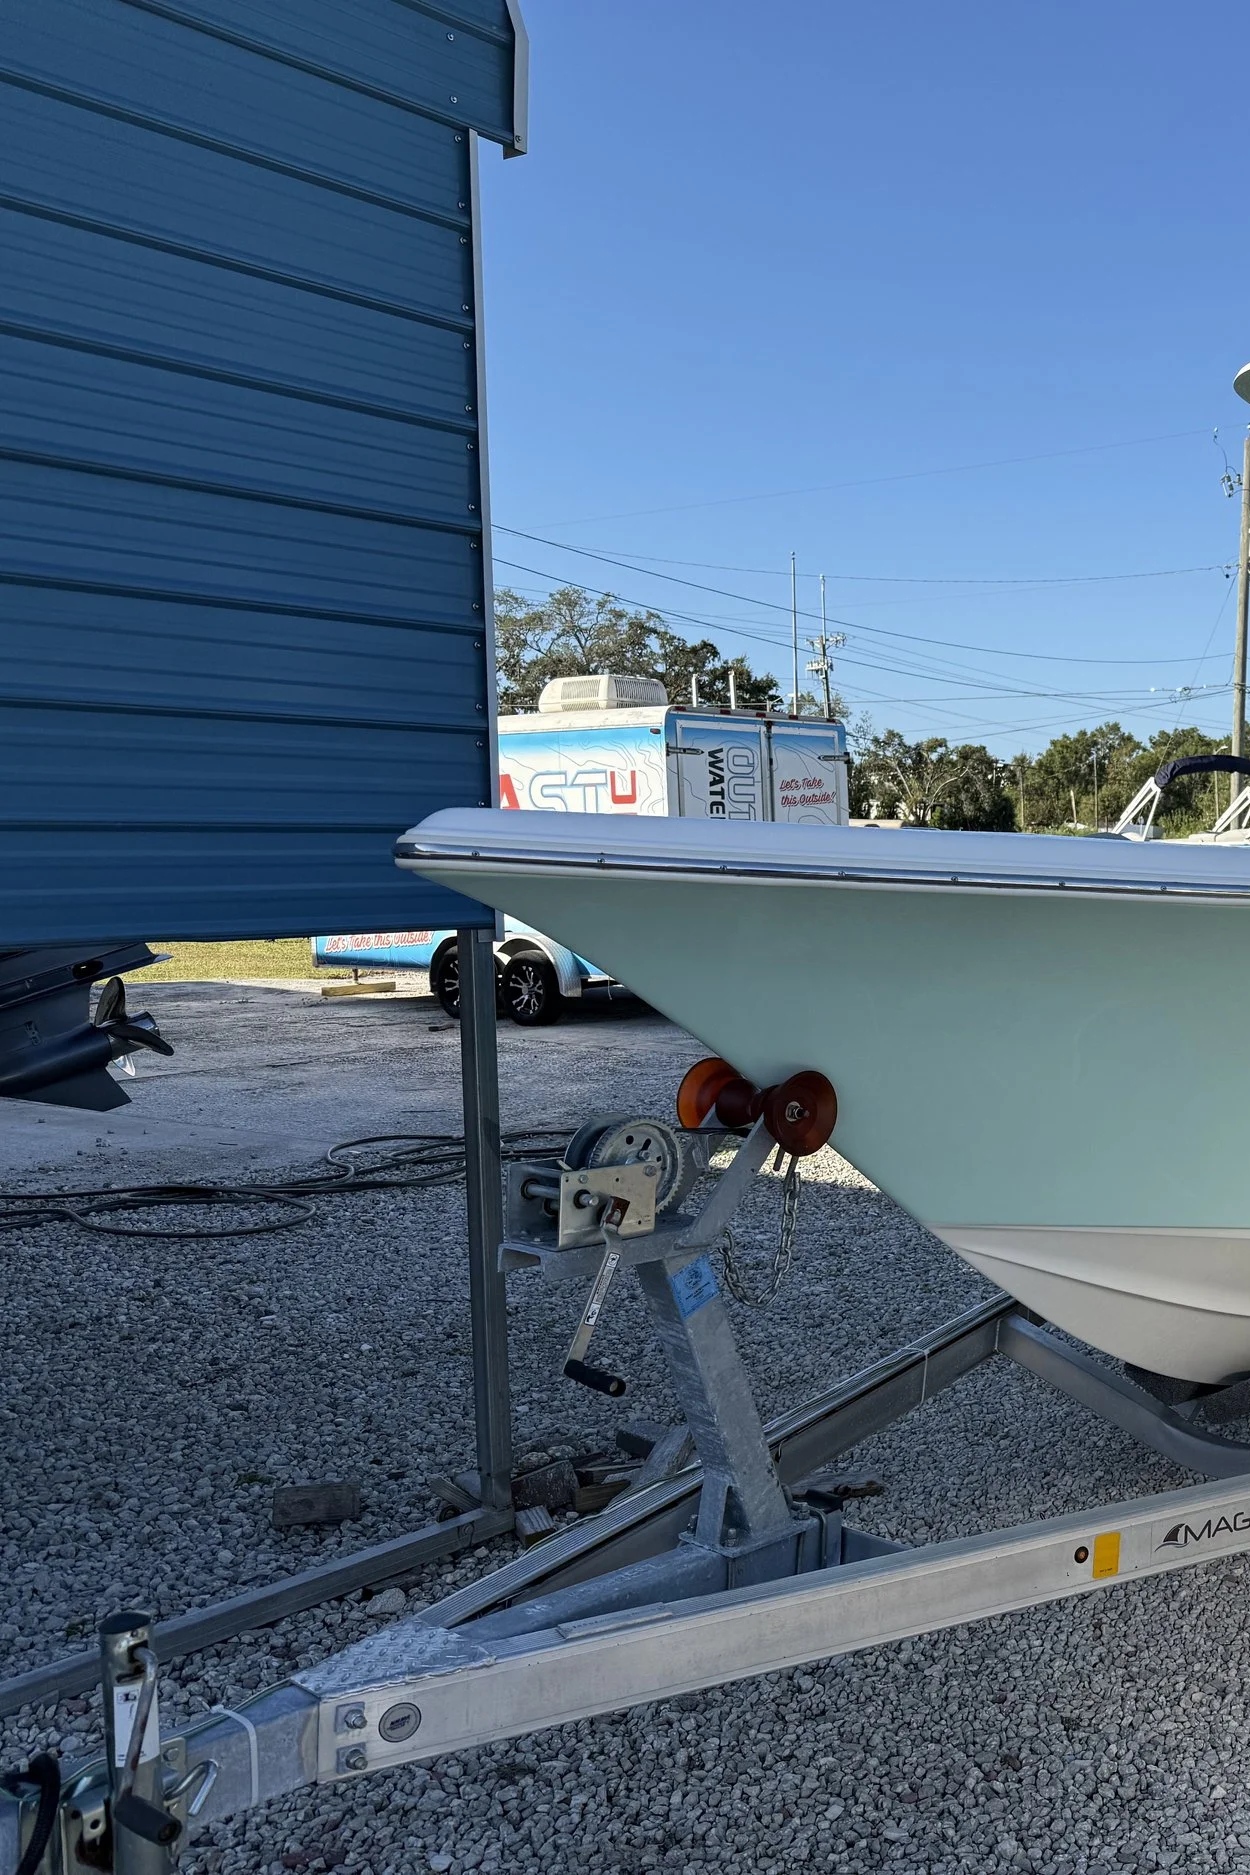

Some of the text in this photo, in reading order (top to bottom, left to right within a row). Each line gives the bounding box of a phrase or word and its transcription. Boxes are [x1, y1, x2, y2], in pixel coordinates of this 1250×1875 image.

[801, 777, 824, 789] Take
[781, 792, 836, 807] this Outside!
[347, 934, 371, 950] Take
